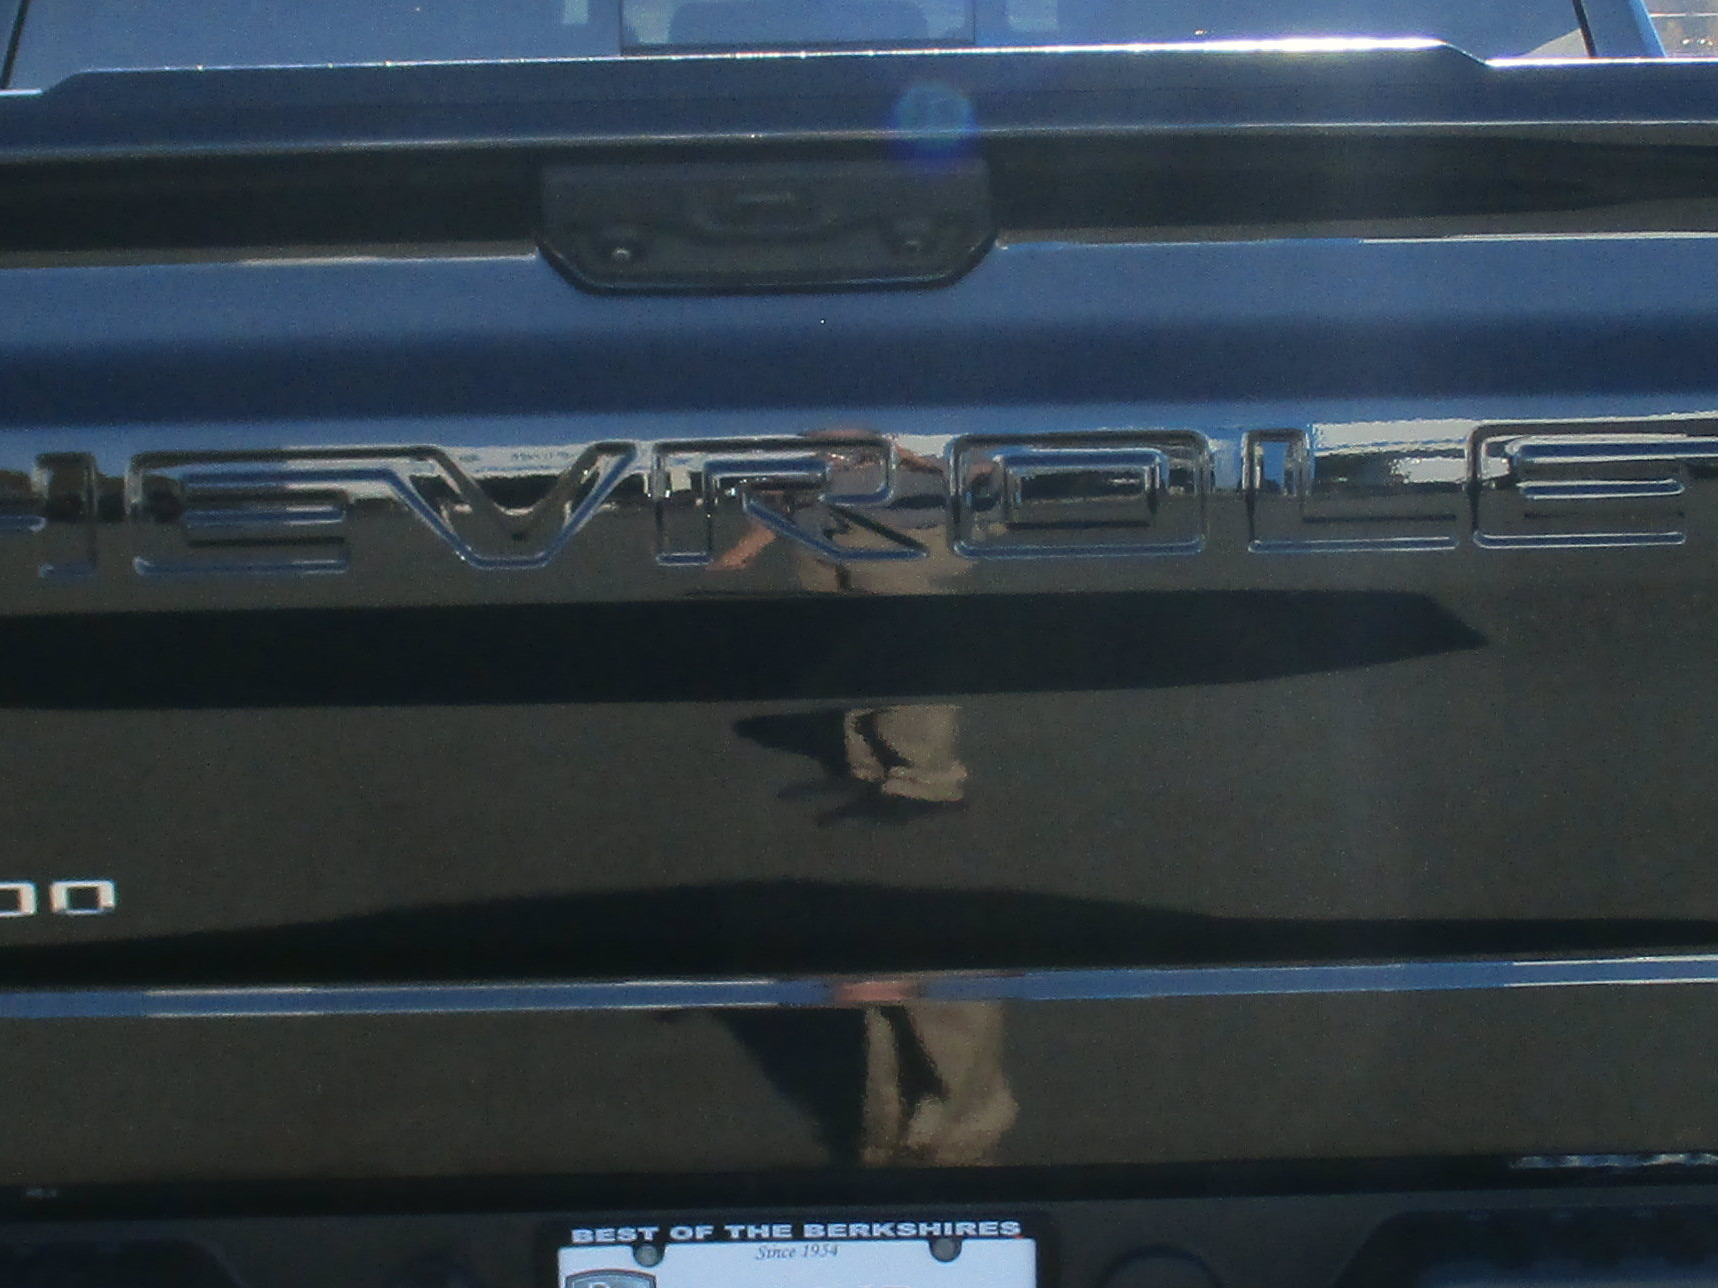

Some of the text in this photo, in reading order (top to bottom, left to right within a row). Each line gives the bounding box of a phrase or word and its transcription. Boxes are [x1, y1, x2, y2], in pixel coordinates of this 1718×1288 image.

[572, 1221, 1021, 1243] BEST OF THE BERKSHIRES
[755, 1245, 796, 1260] Since
